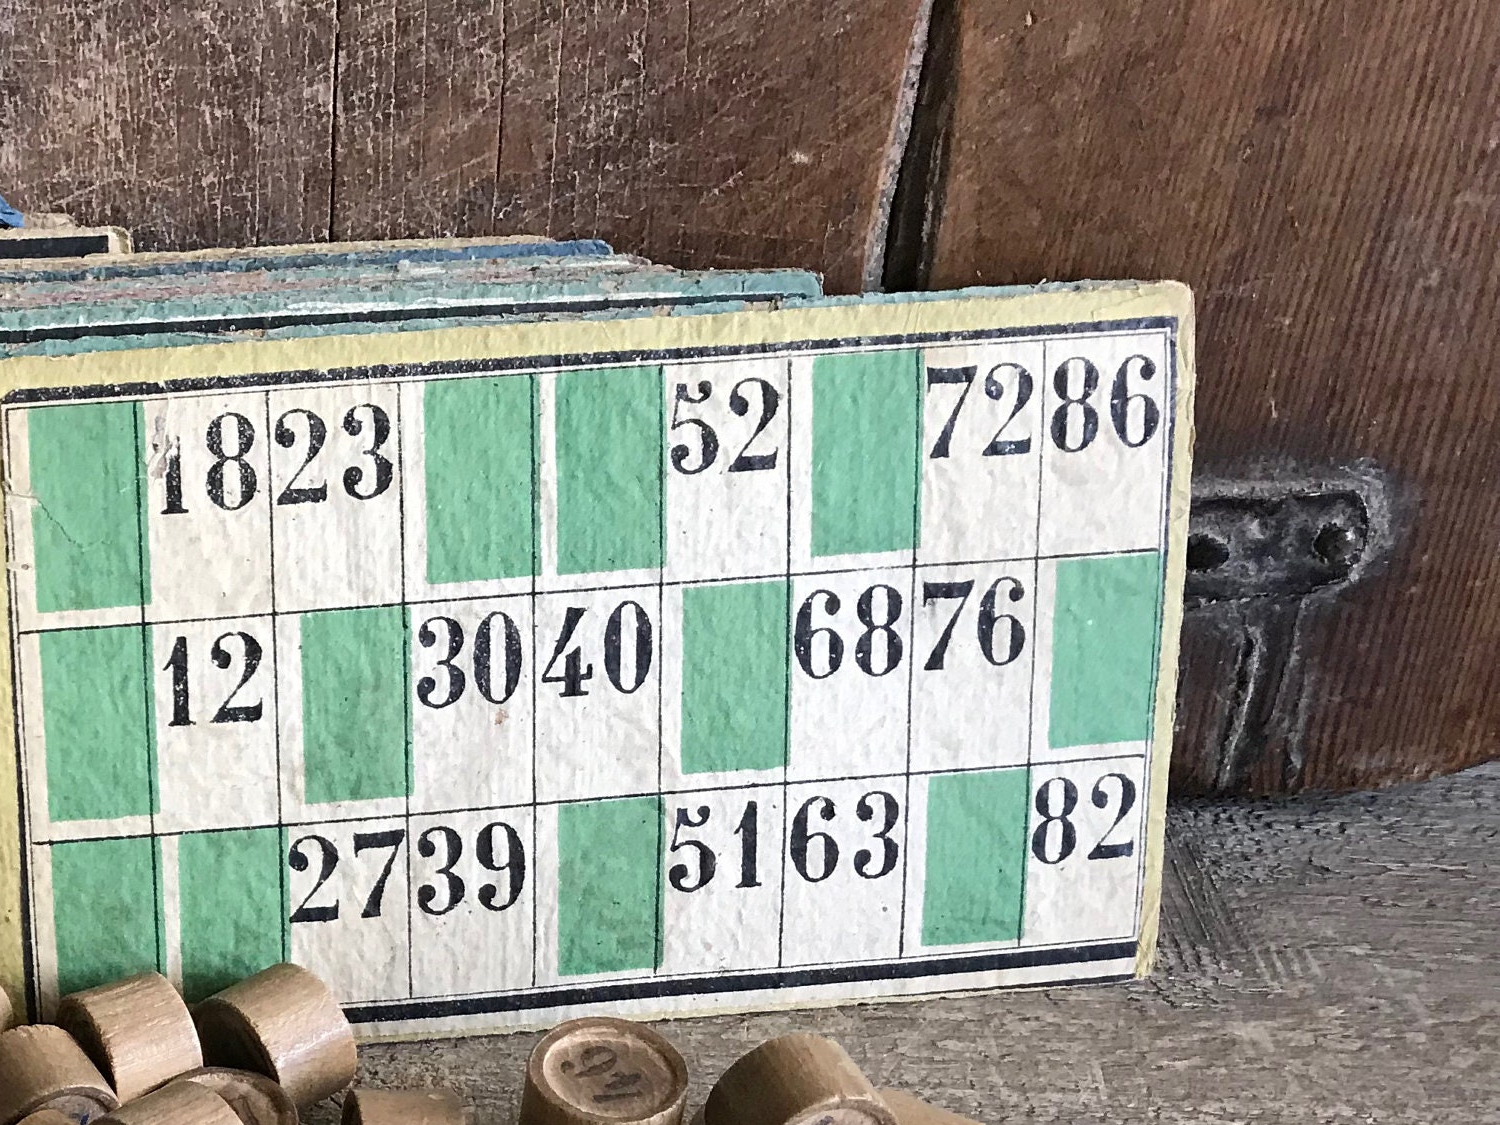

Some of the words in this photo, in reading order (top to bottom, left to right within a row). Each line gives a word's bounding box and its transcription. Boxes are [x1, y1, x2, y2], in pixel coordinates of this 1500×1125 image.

[150, 412, 256, 515] 18
[275, 404, 394, 505] 23
[670, 378, 780, 474] 52
[926, 363, 1034, 459] 72
[1051, 355, 1159, 453] 86
[162, 632, 263, 727] 12
[417, 611, 522, 708] 30
[542, 600, 652, 698] 40
[794, 584, 903, 679] 68
[922, 576, 1026, 671] 76
[289, 829, 405, 923] 27
[417, 823, 525, 915] 39
[669, 801, 763, 892] 51
[791, 791, 898, 882] 63
[1032, 774, 1135, 864] 82
